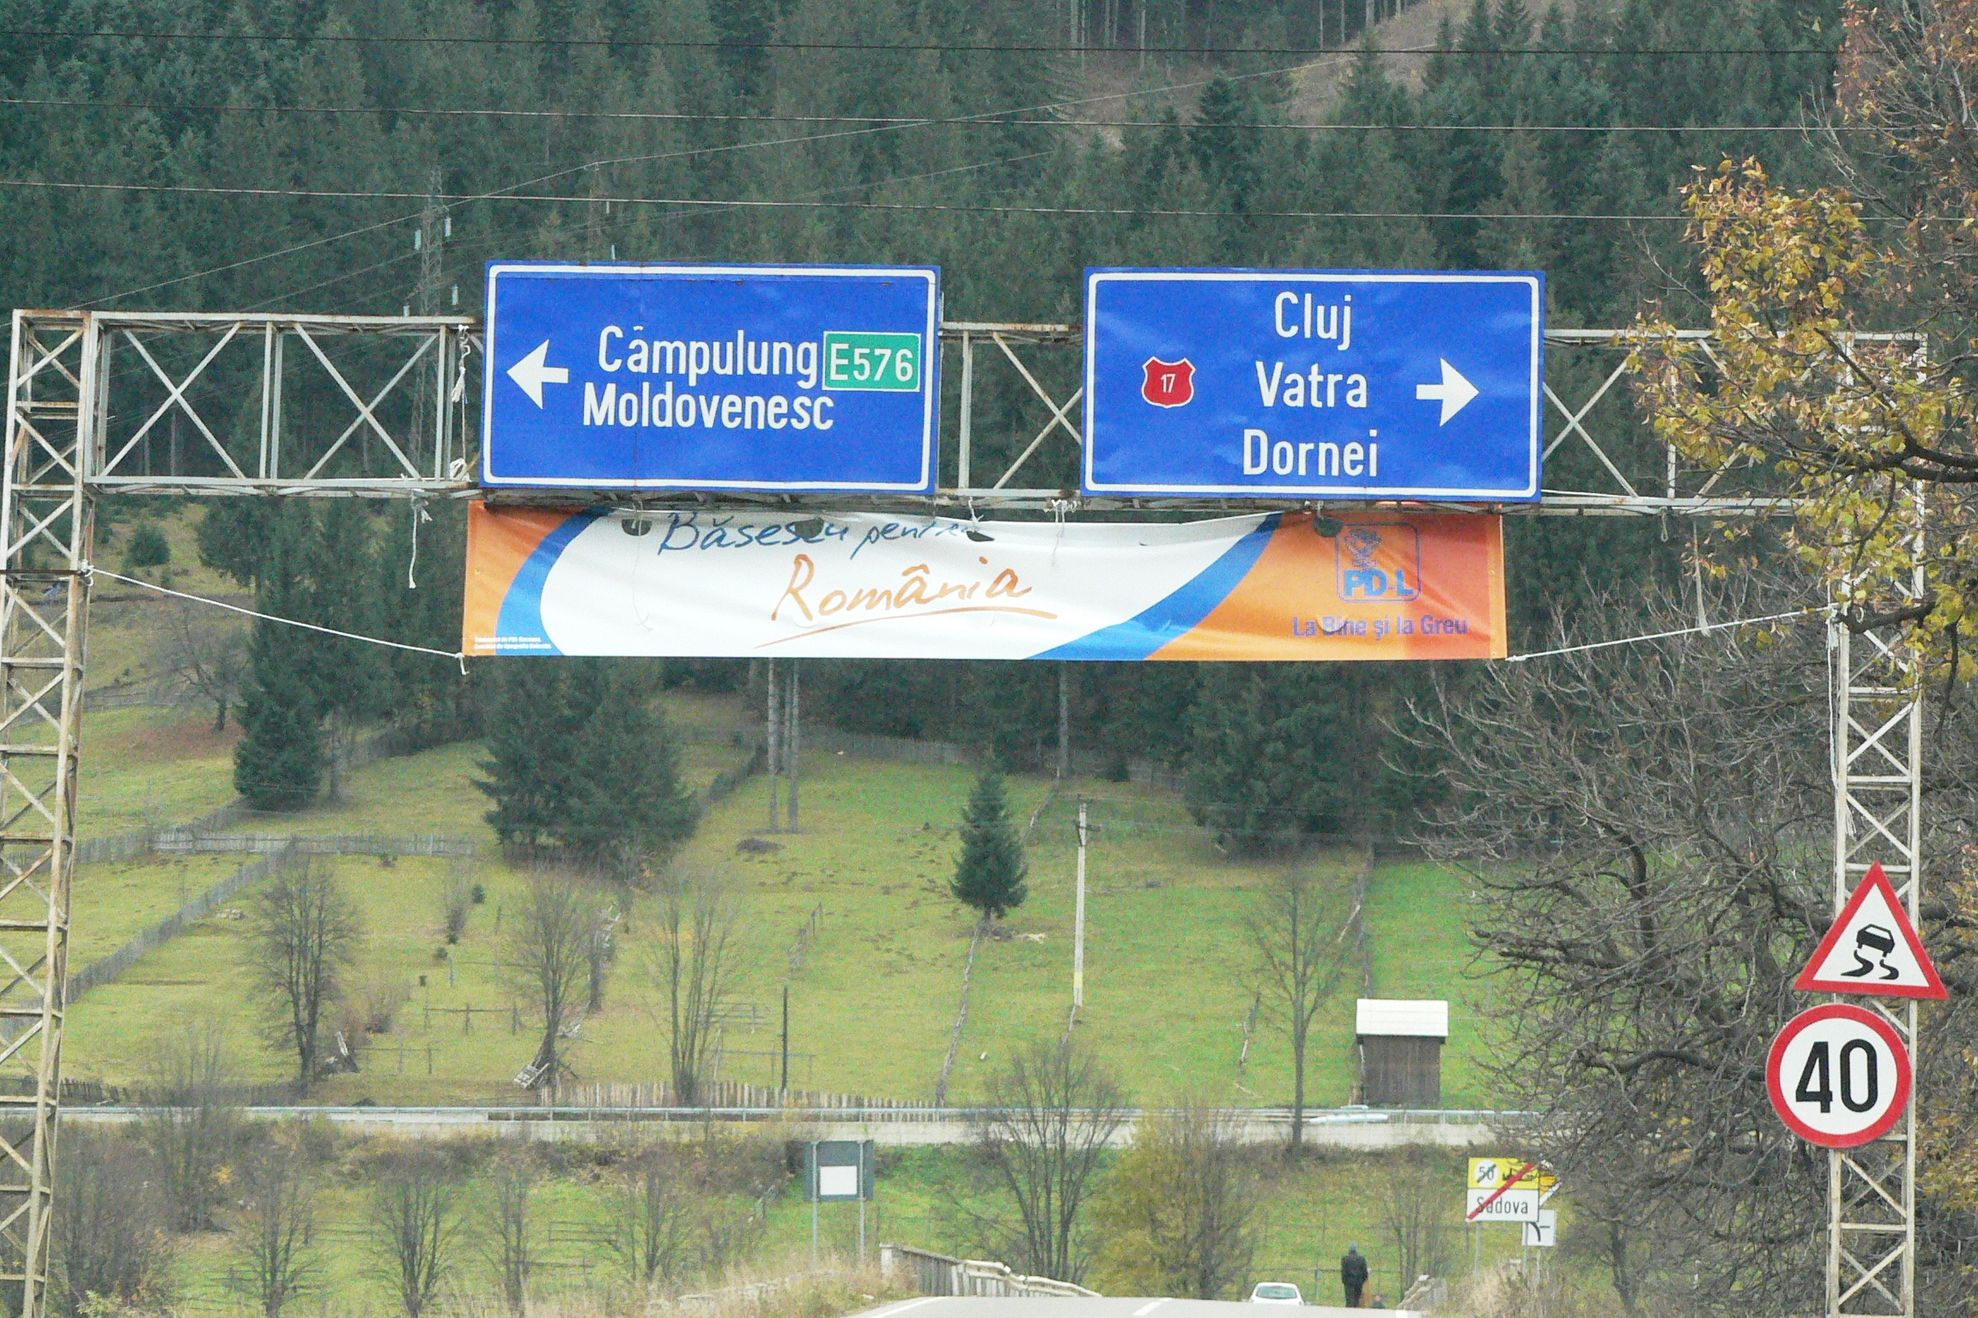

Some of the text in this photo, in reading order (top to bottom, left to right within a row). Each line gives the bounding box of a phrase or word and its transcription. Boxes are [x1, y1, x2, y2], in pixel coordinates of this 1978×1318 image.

[1274, 291, 1353, 352] Cluj
[830, 342, 916, 382] E576
[1160, 373, 1177, 393] 17
[1255, 360, 1369, 409] Vatra
[582, 381, 835, 431] Moldovenesc
[1243, 428, 1379, 478] Dornei
[771, 554, 1033, 621] România
[1292, 616, 1317, 637] La
[1397, 615, 1415, 635] la
[1420, 614, 1468, 636] Greu
[1795, 1038, 1879, 1114] 40
[1479, 1166, 1495, 1181] 50
[1476, 1196, 1529, 1215] Sadova
